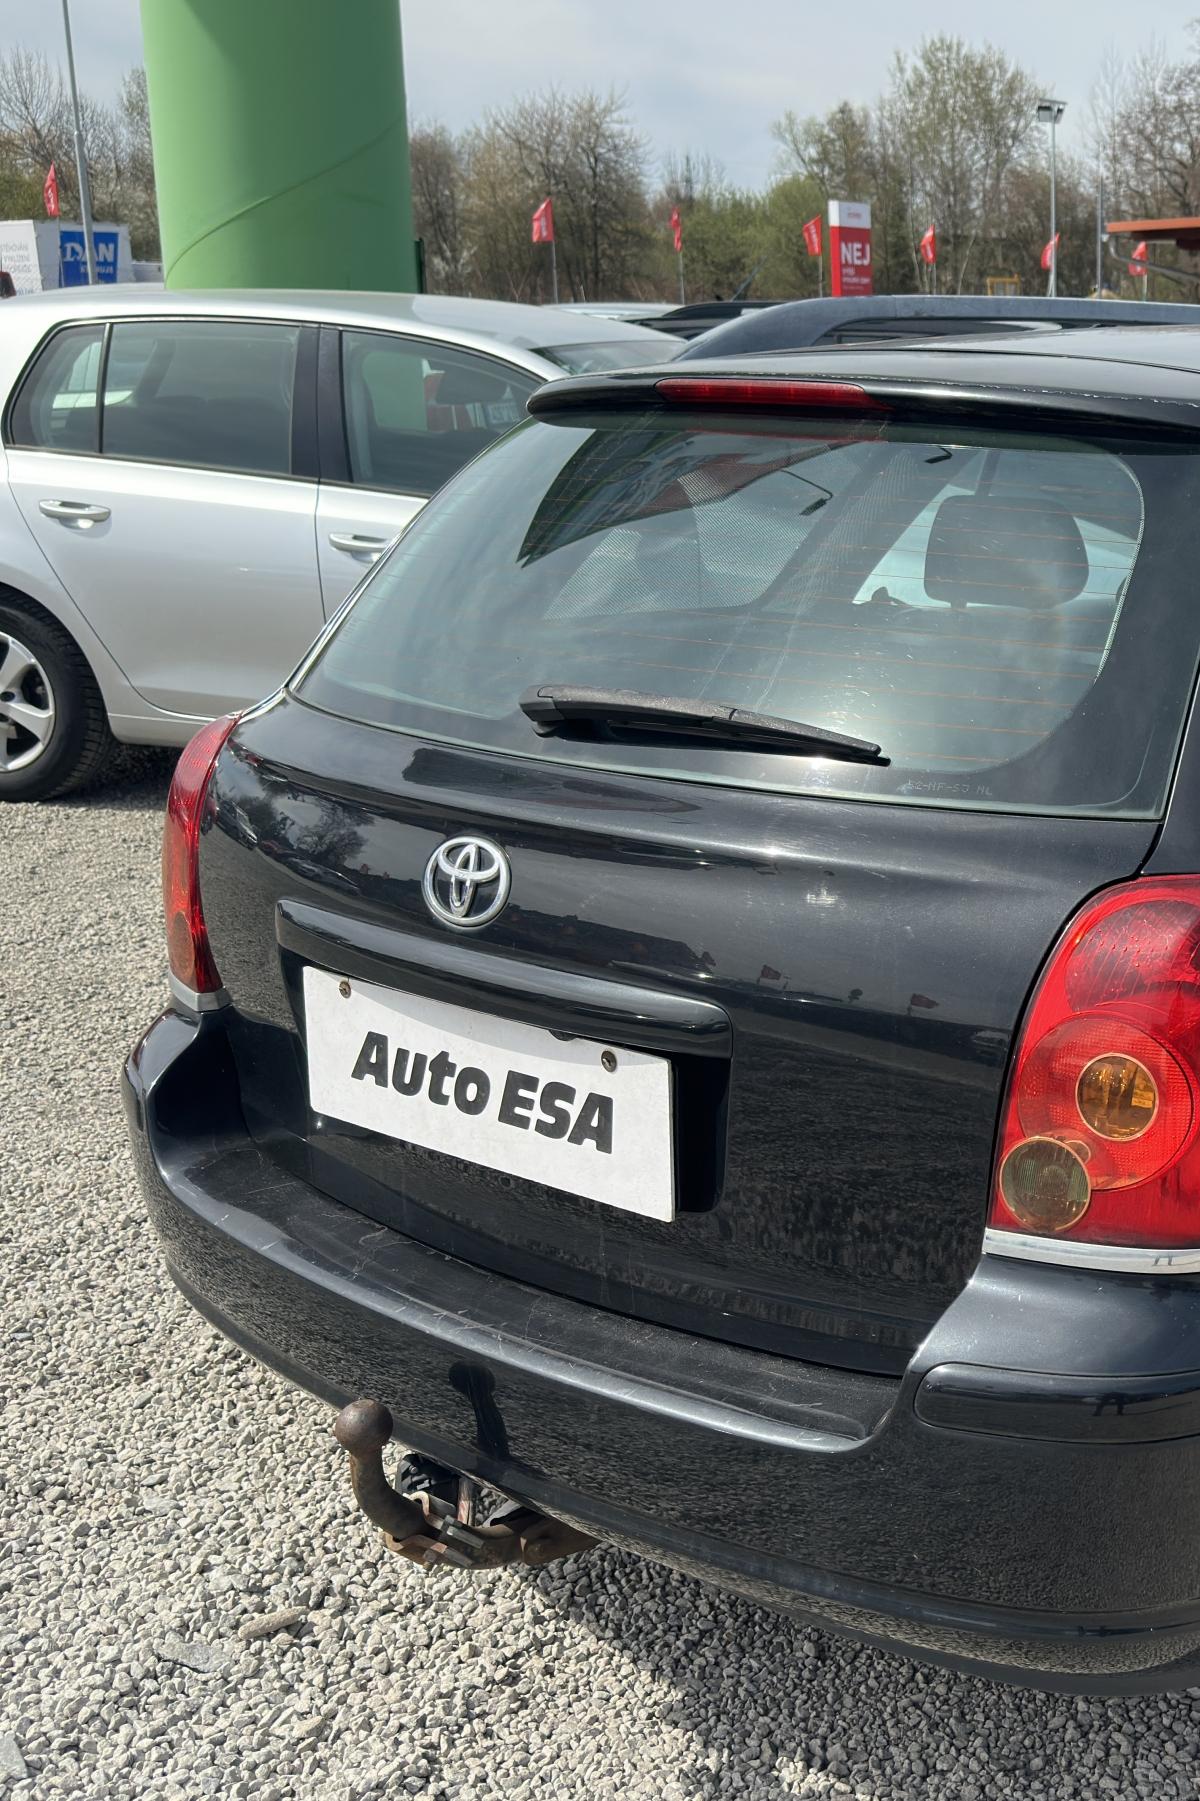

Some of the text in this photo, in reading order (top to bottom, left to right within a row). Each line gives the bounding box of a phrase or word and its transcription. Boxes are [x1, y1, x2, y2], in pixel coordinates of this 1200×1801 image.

[841, 241, 871, 266] NEJ
[351, 1030, 614, 1155] Auto ESA
